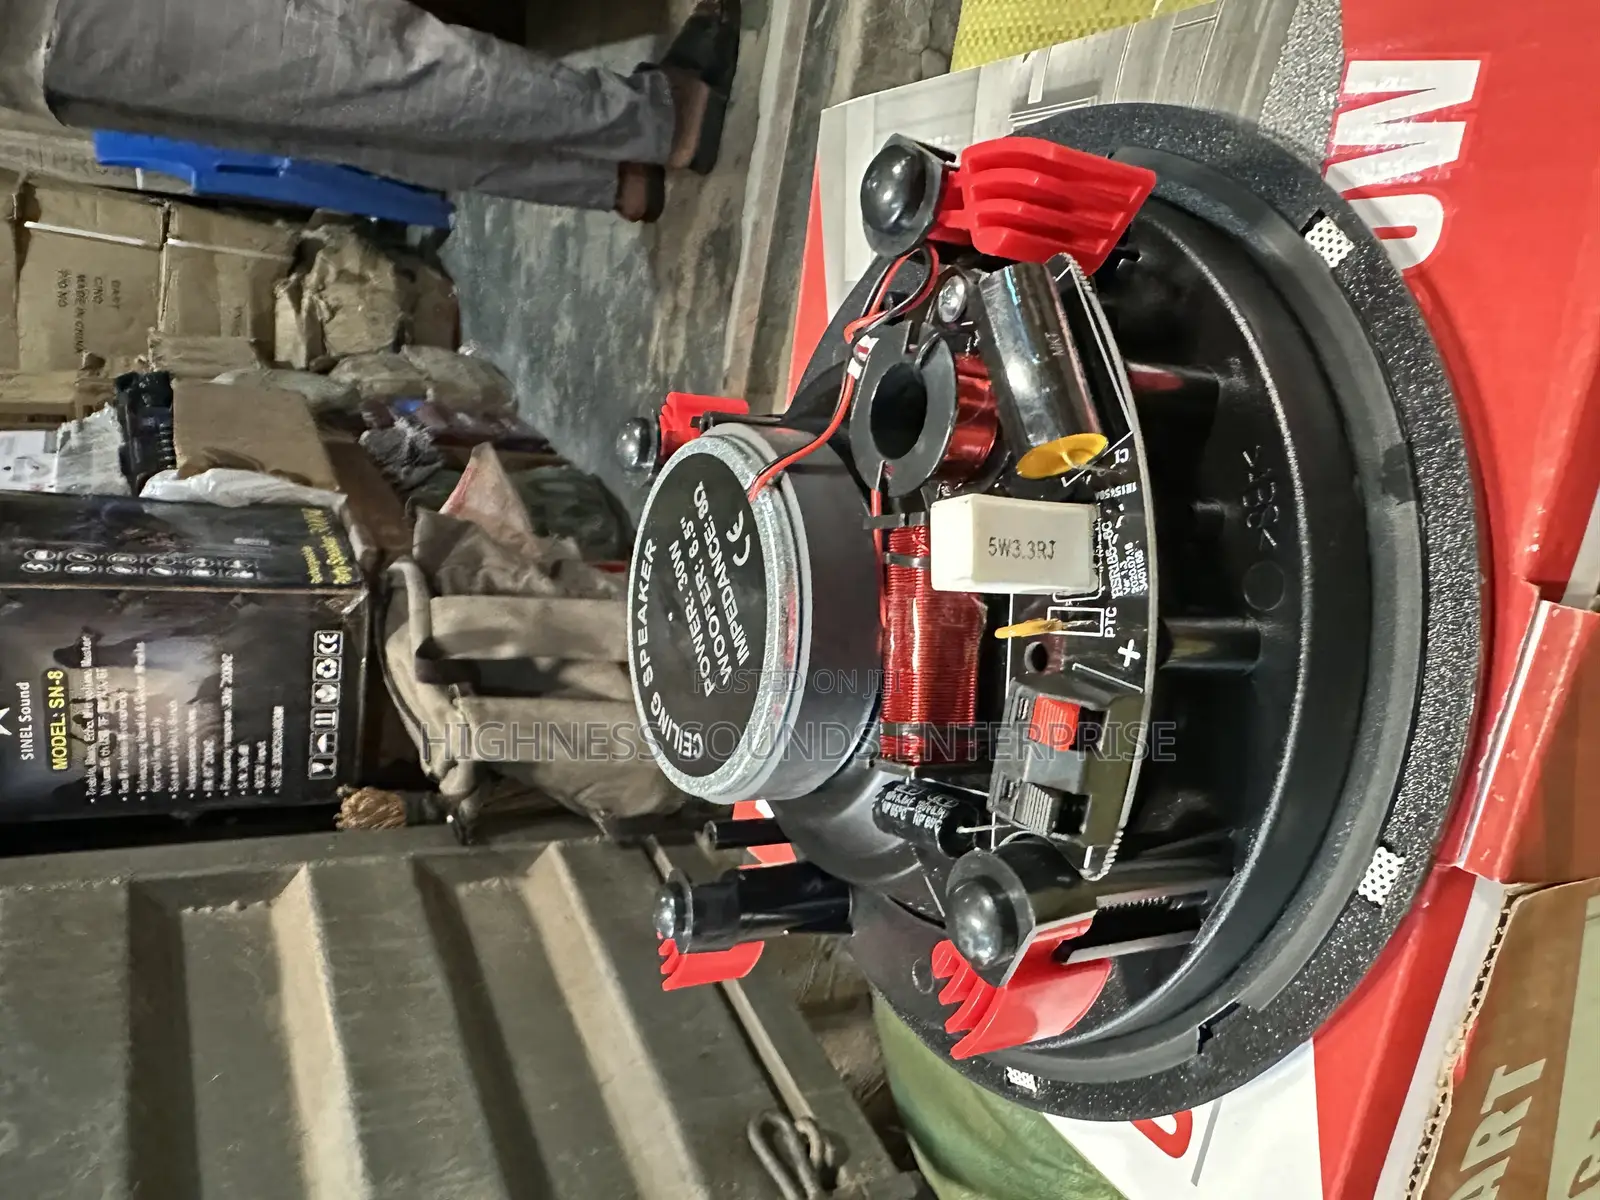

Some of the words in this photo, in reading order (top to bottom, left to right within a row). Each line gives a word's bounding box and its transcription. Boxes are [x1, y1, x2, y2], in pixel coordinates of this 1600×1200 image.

[668, 541, 690, 591] 30W
[988, 536, 1056, 560] 5W3.3RJ
[636, 537, 658, 688] SPEAKER
[704, 515, 750, 667] IMPEDANCE:
[684, 591, 715, 698] POWER:
[698, 559, 731, 686] WOOFER:
[1104, 606, 1117, 638] PTC
[16, 682, 33, 722] Sound
[47, 670, 64, 708] SN-8
[19, 725, 34, 760] SINEL
[50, 712, 68, 770] MODEL:
[650, 692, 704, 760] CEILING
